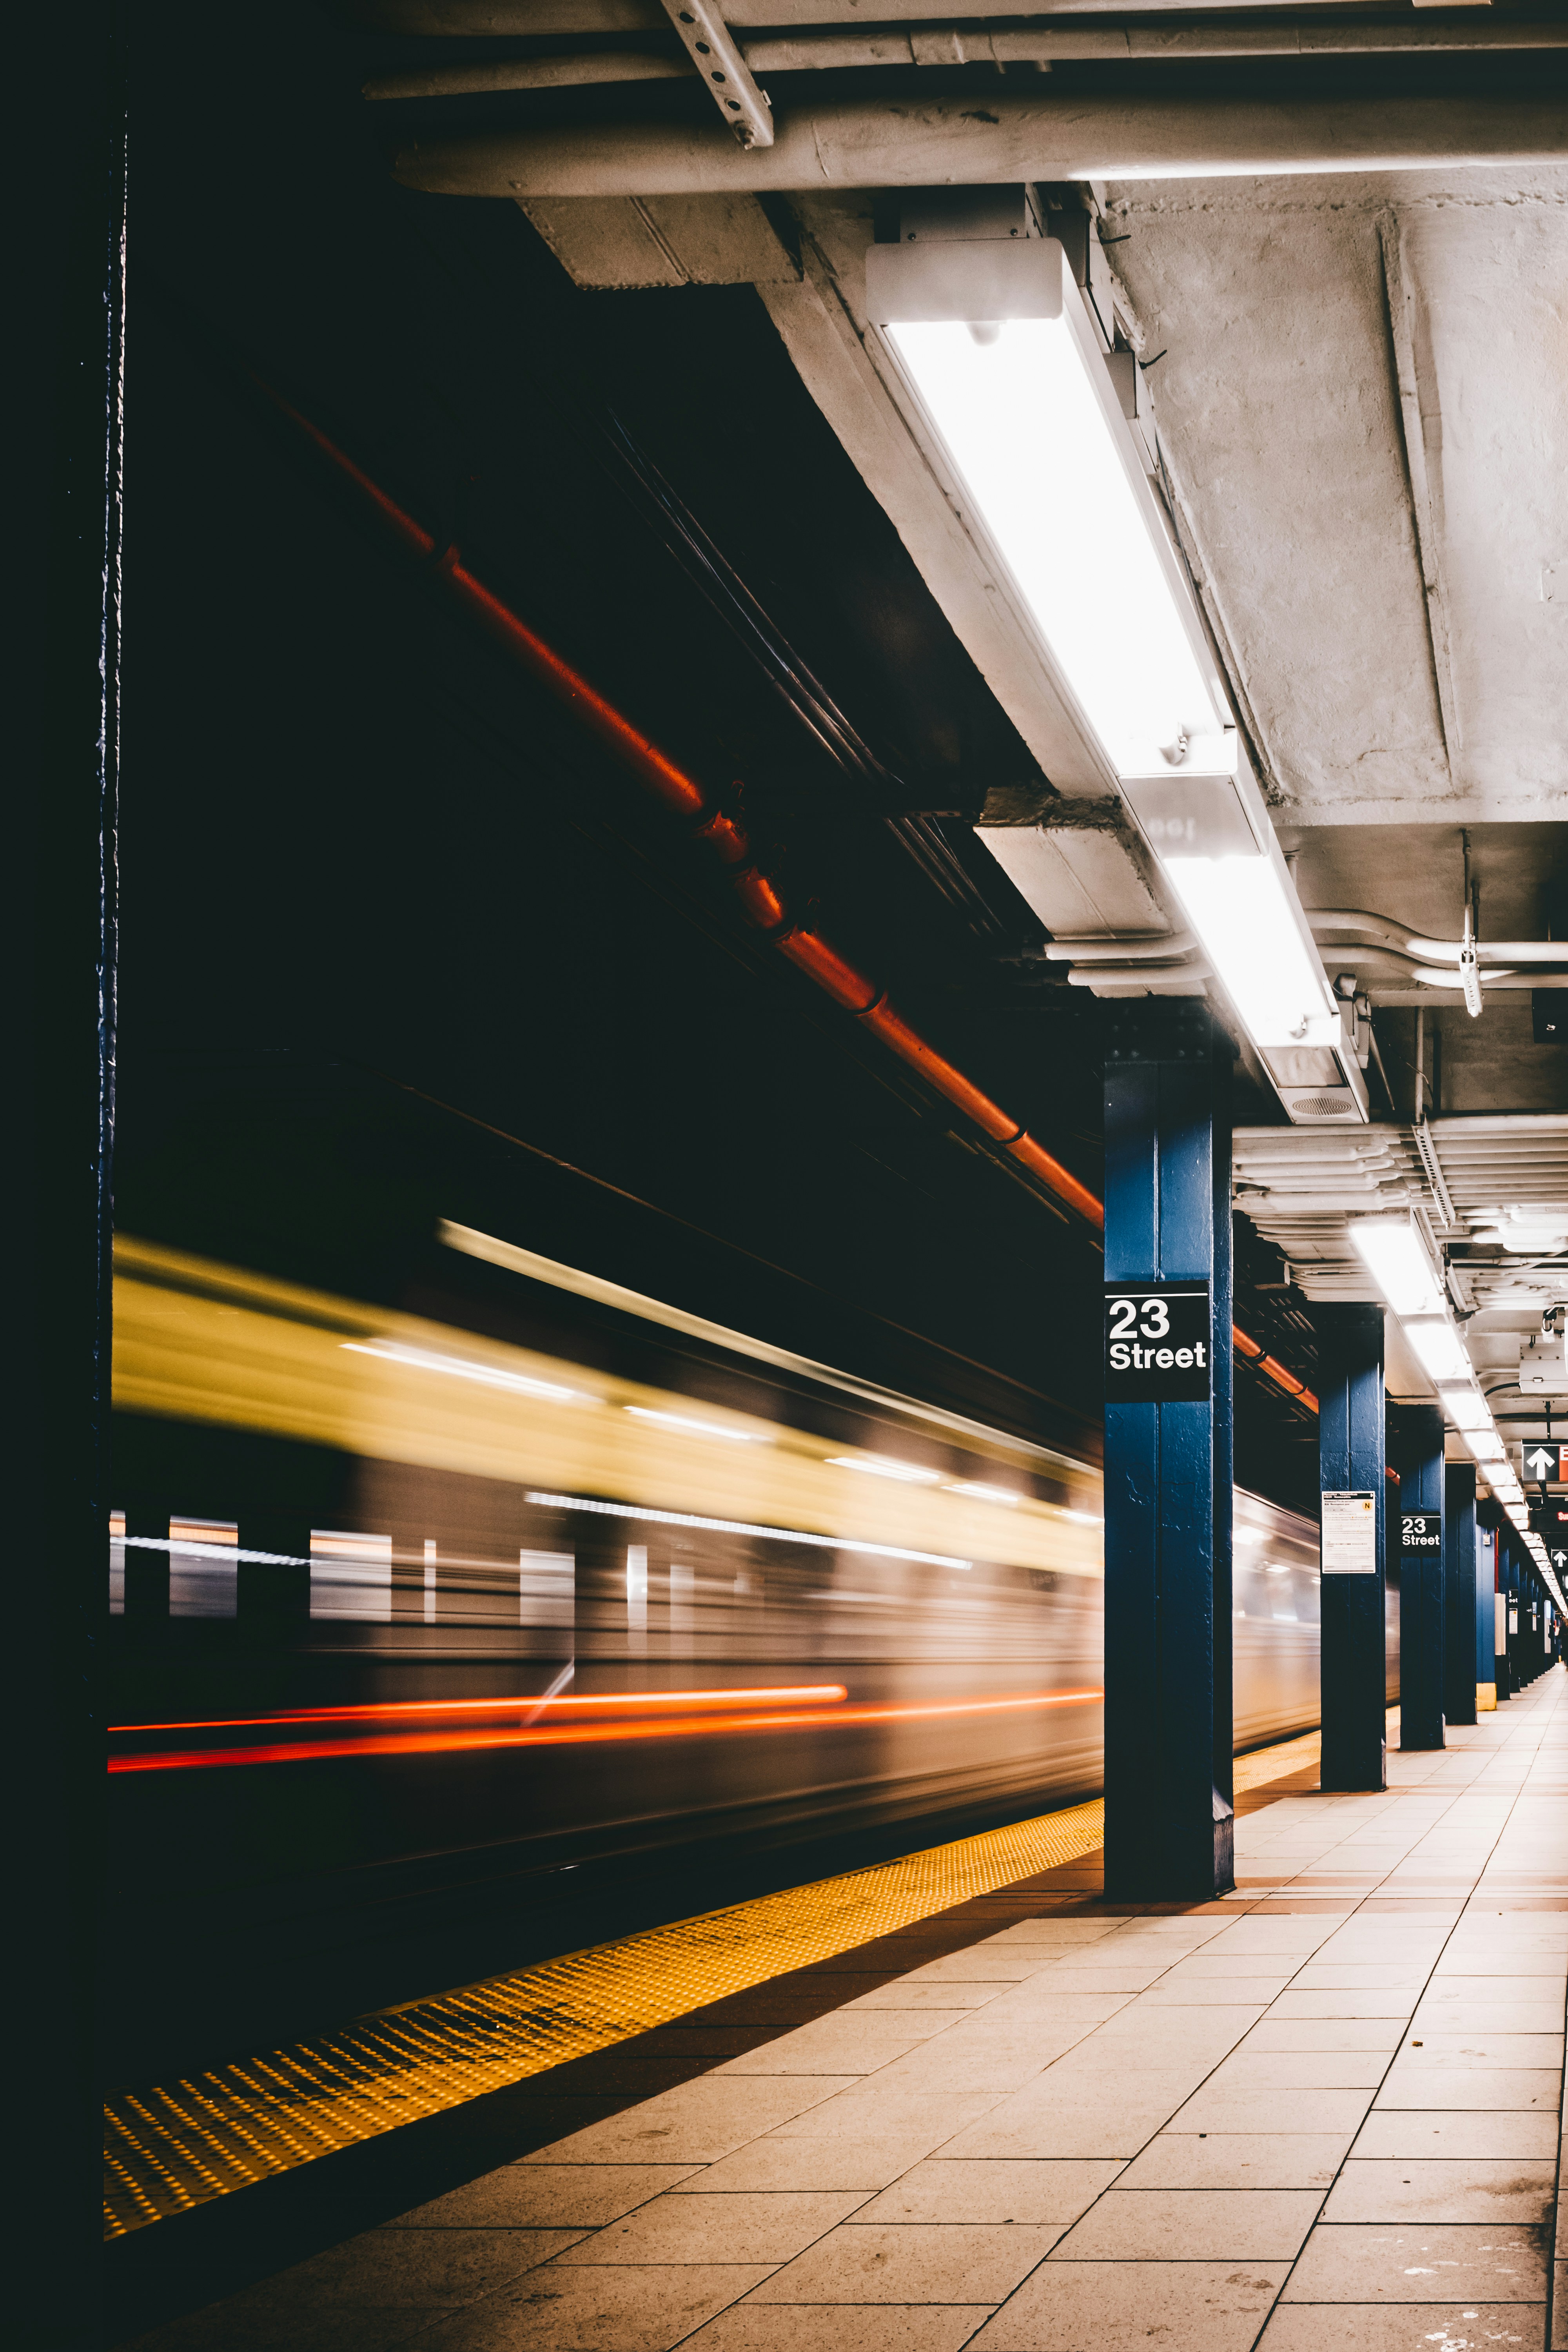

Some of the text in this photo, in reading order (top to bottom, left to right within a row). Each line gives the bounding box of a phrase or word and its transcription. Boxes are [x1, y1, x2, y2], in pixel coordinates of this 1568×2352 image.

[1109, 1299, 1170, 1339] 23
[1110, 1342, 1206, 1370] Street
[1402, 1518, 1426, 1534] 23
[1402, 1535, 1440, 1545] Street
